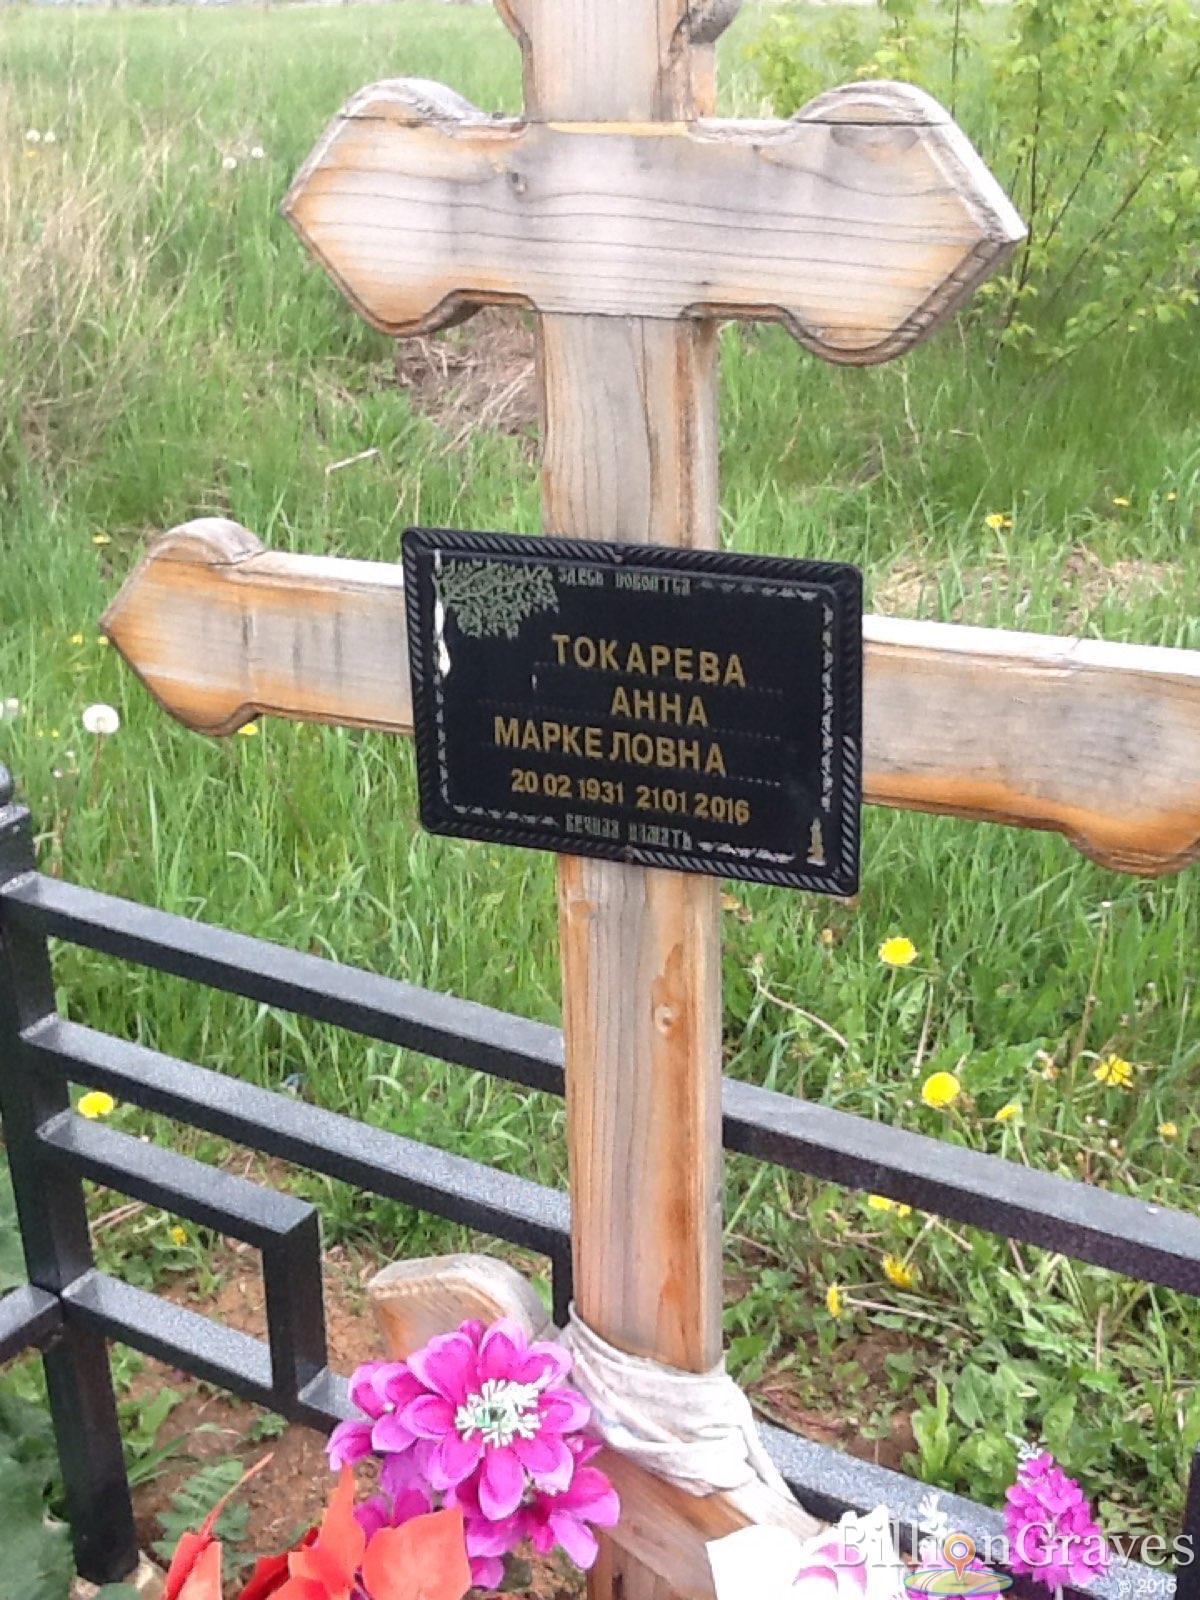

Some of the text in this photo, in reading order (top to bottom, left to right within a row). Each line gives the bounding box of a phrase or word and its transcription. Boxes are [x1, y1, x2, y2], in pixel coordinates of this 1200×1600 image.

[552, 633, 747, 688] ТОКАРЕВА
[610, 686, 709, 728] АННА
[694, 793, 750, 825] 2016
